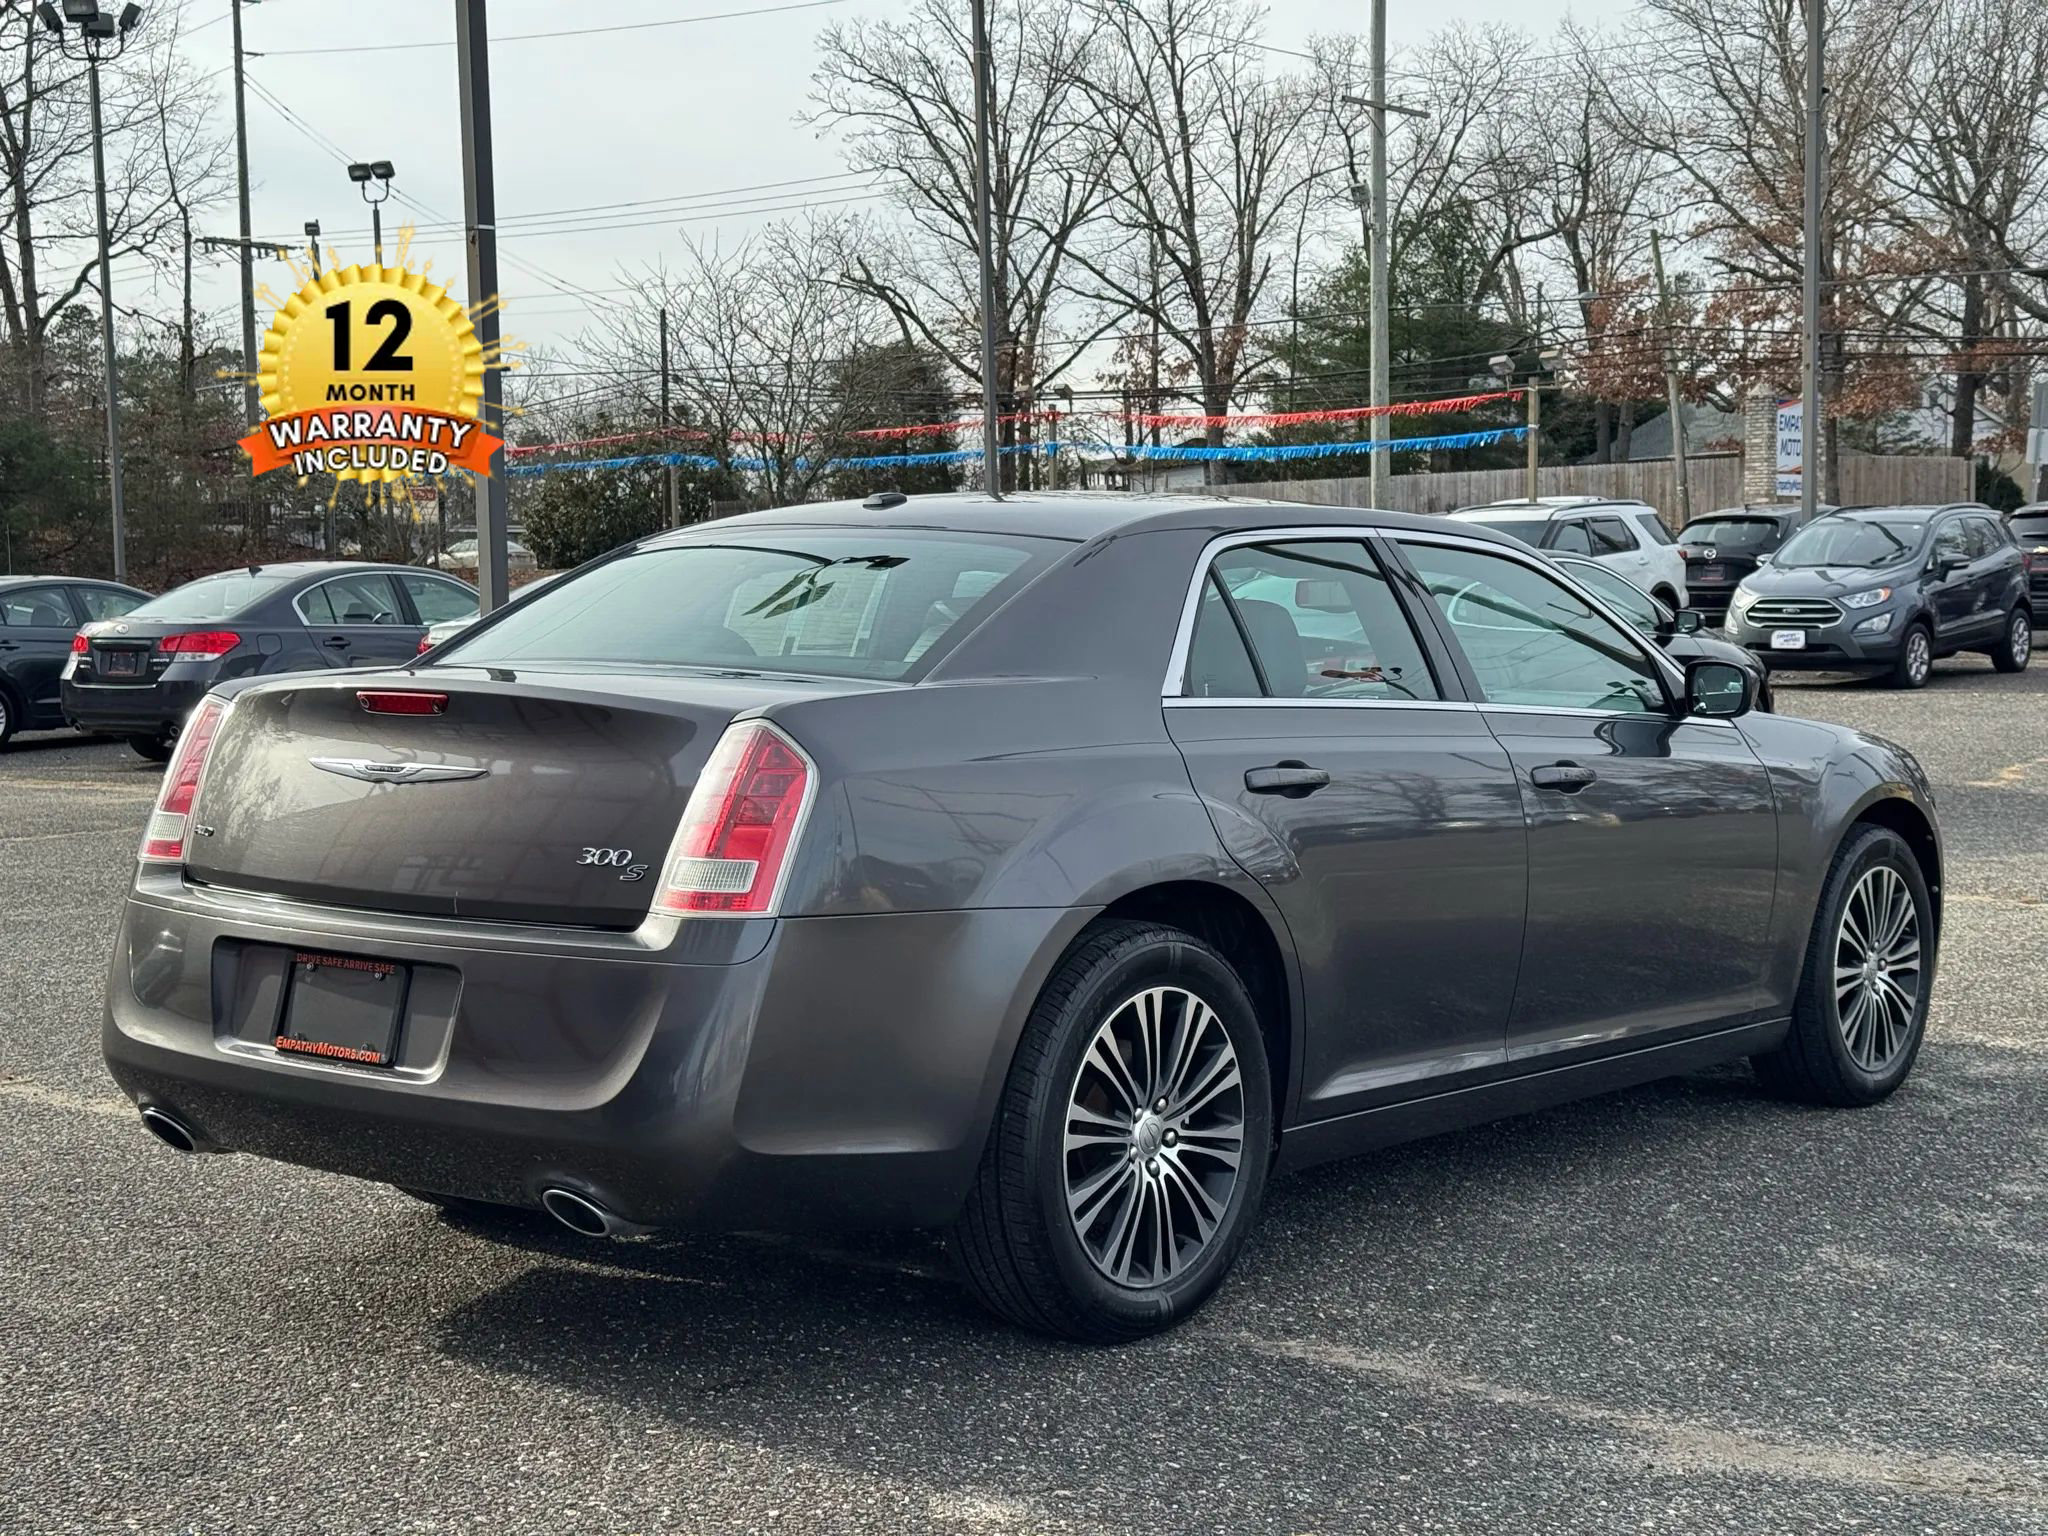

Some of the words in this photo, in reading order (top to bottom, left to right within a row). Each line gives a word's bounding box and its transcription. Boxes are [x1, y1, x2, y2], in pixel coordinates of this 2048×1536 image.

[1779, 414, 1803, 432] EMPAT
[1780, 438, 1802, 457] MOTO
[576, 847, 633, 867] 300
[619, 864, 649, 881] S
[296, 953, 321, 965] DRIVE
[322, 956, 343, 968] SAFE
[343, 959, 373, 971] ARRIVE
[374, 963, 396, 975] SAFE
